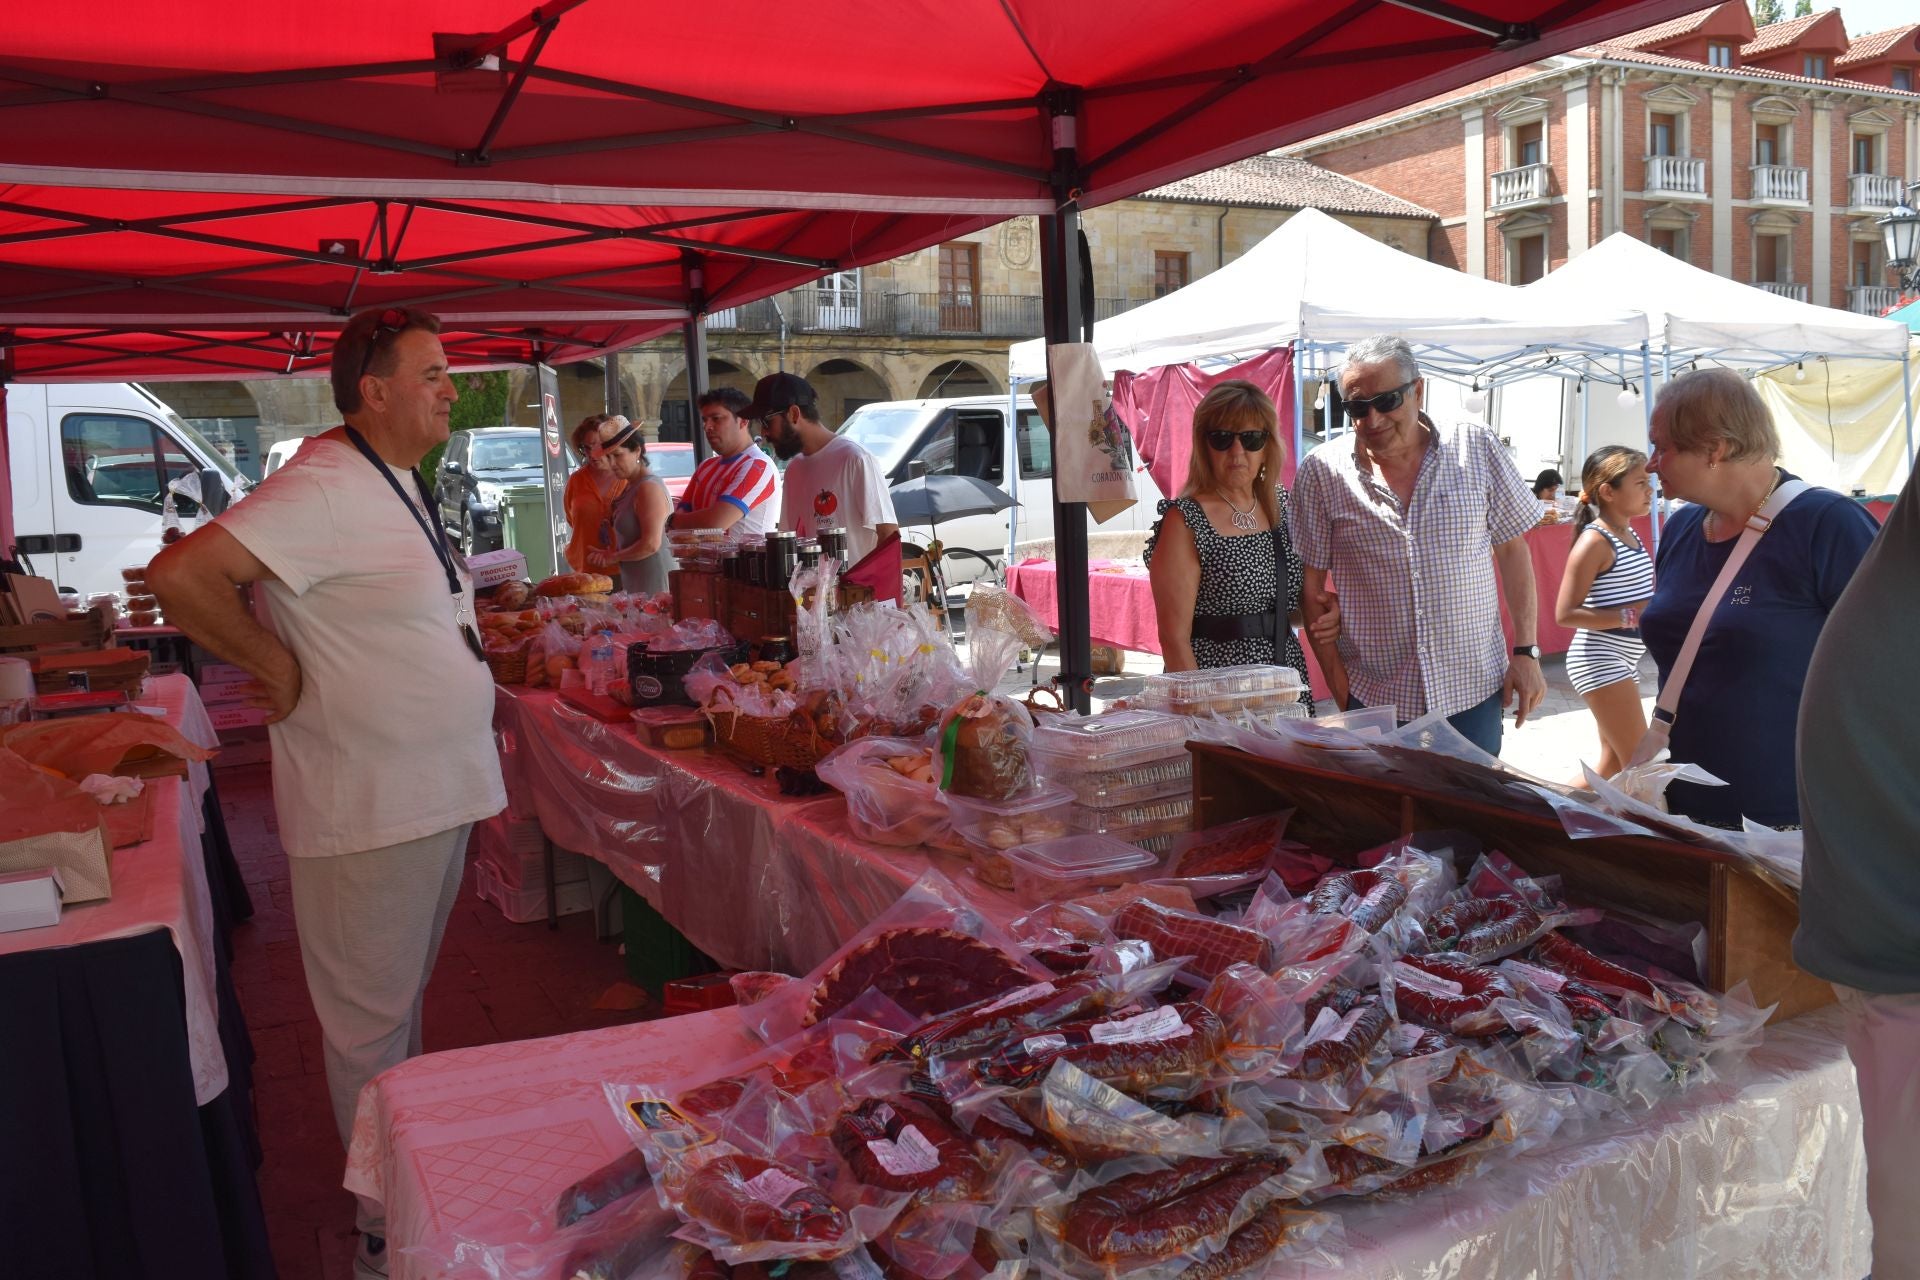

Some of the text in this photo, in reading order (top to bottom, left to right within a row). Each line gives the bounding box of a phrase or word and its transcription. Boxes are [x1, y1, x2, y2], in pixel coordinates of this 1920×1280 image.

[1091, 471, 1122, 483] CORAZON
[480, 564, 518, 577] PRODUCTO
[484, 571, 516, 583] GALLEGO
